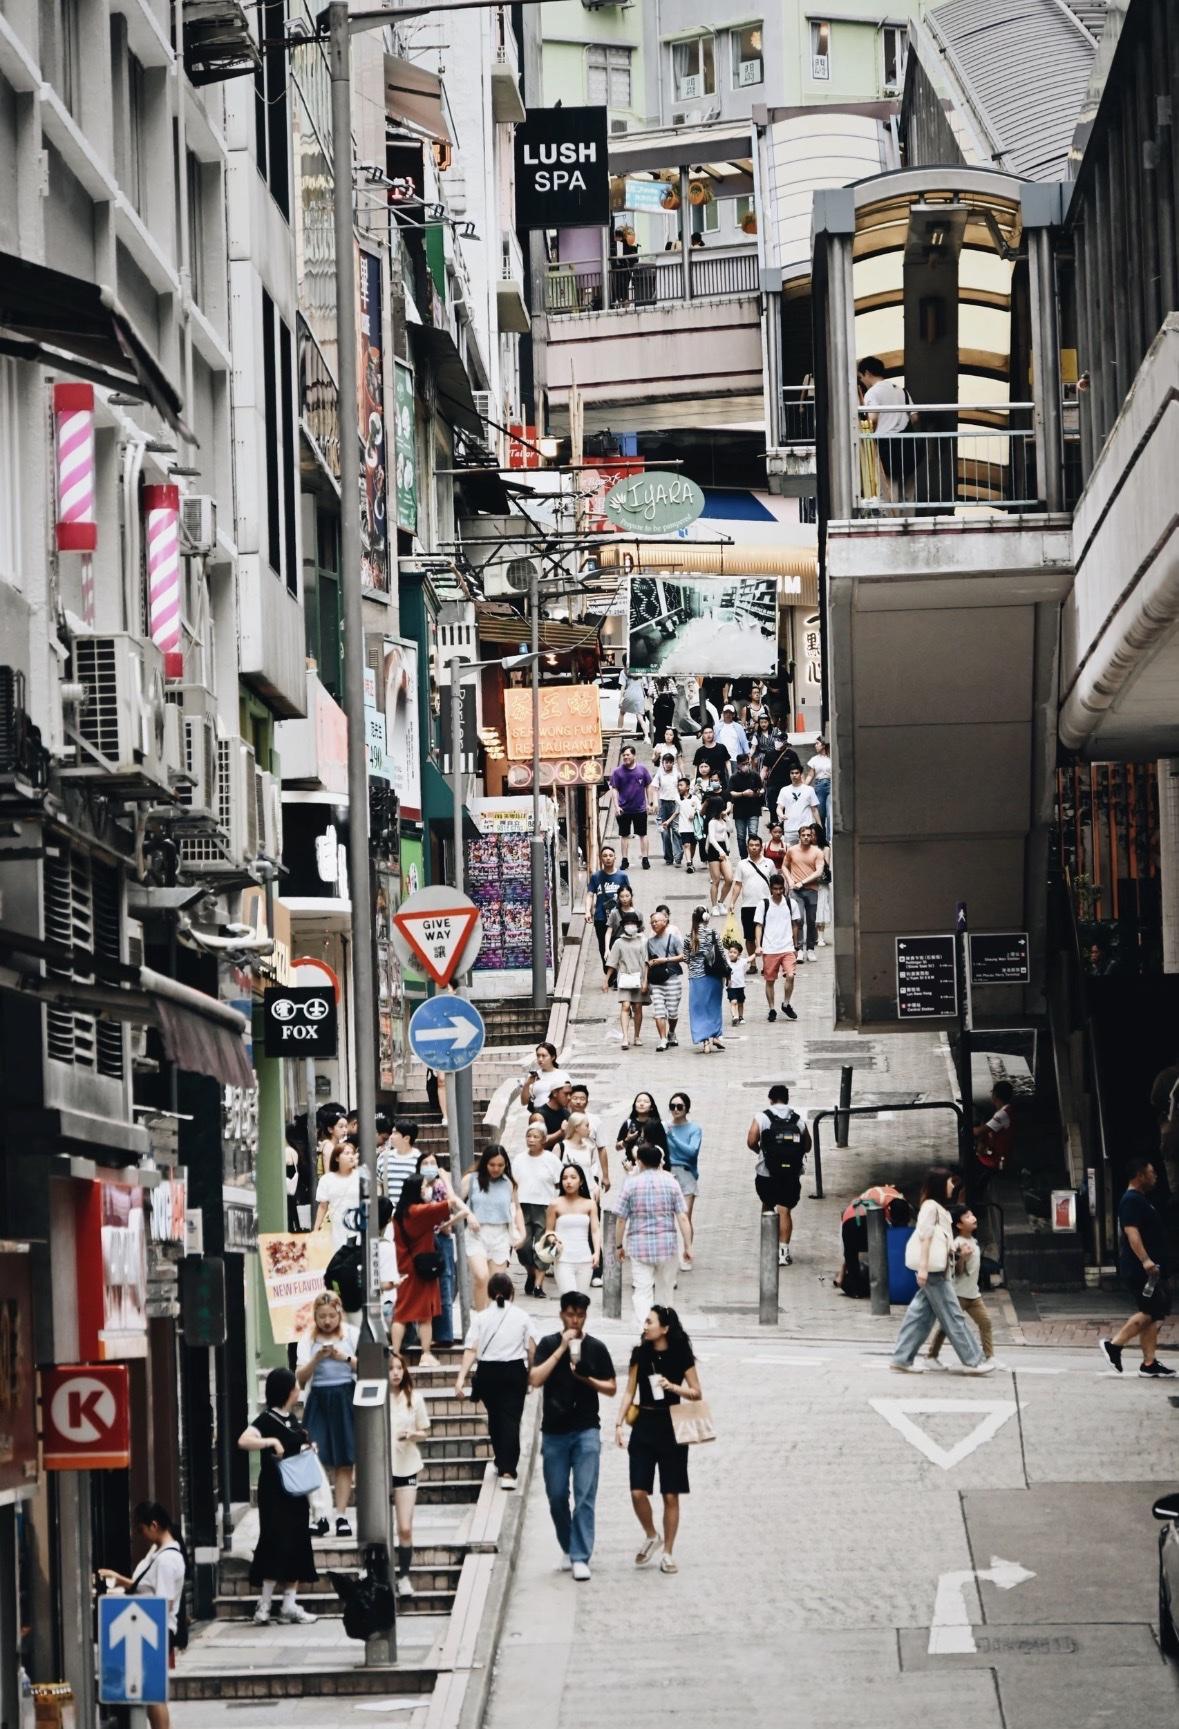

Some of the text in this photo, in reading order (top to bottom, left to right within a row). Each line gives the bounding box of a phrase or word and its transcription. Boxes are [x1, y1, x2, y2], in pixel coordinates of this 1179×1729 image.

[523, 142, 597, 165] LUSH
[534, 170, 587, 192] SPA
[539, 726, 572, 737] WONG
[574, 723, 597, 735] FUN
[422, 918, 451, 930] GIVE
[425, 930, 452, 941] WAY
[433, 945, 446, 959] 讓
[281, 1025, 319, 1040] FOX
[272, 1277, 326, 1297] NEW FLAVOU
[67, 1391, 113, 1438] K
